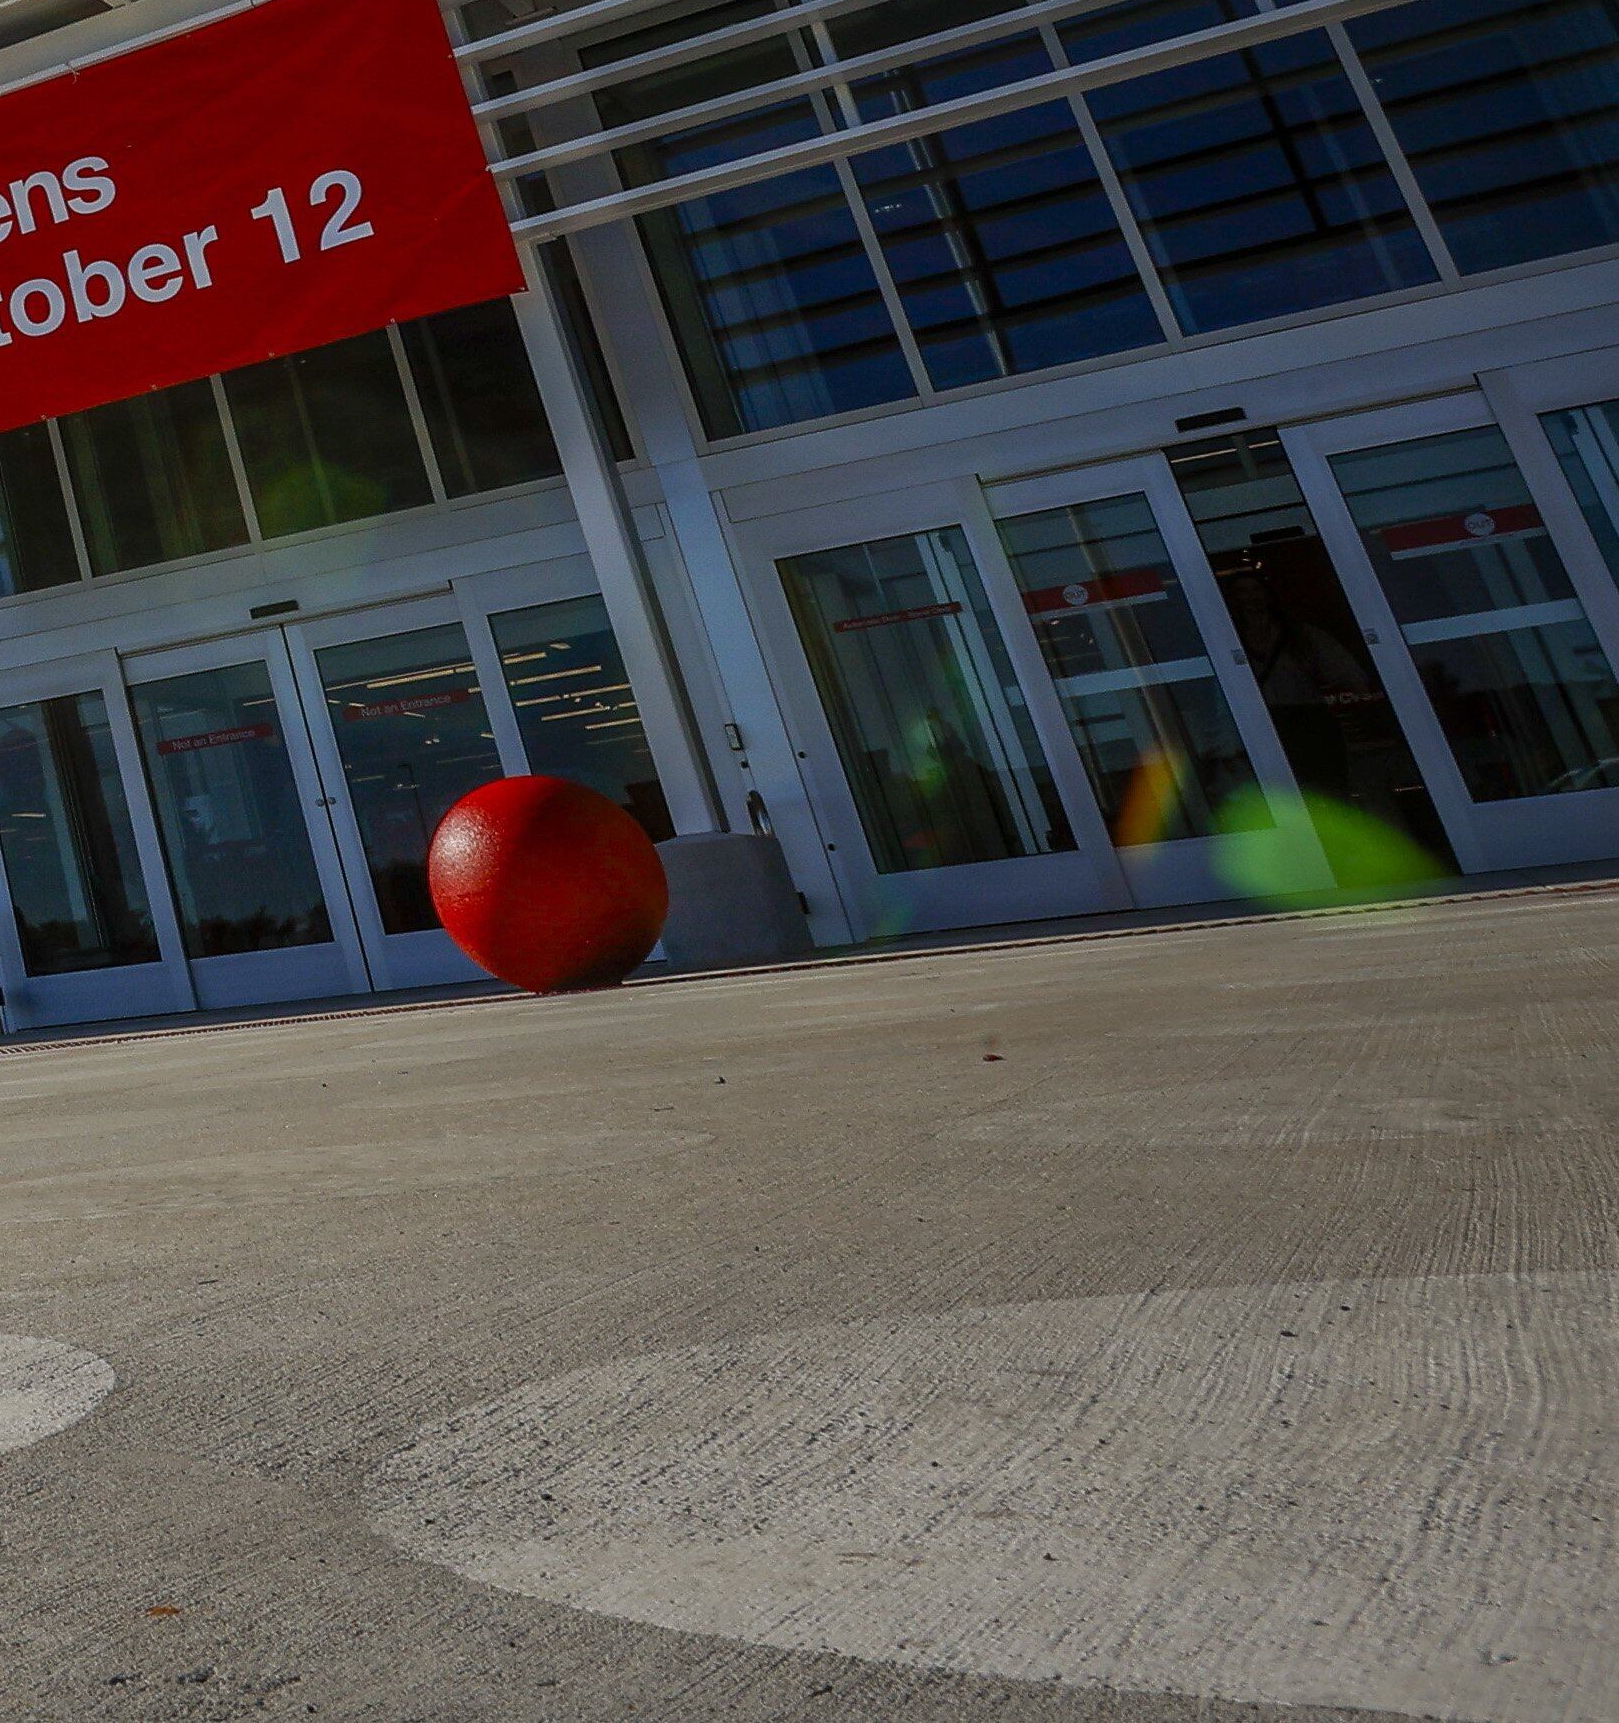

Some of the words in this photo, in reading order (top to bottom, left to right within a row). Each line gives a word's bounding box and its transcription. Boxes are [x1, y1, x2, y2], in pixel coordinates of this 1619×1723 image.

[250, 169, 376, 264] 12
[360, 706, 381, 718] Not
[171, 738, 191, 751] Not
[193, 738, 207, 747] an
[208, 729, 256, 745] Entrance
